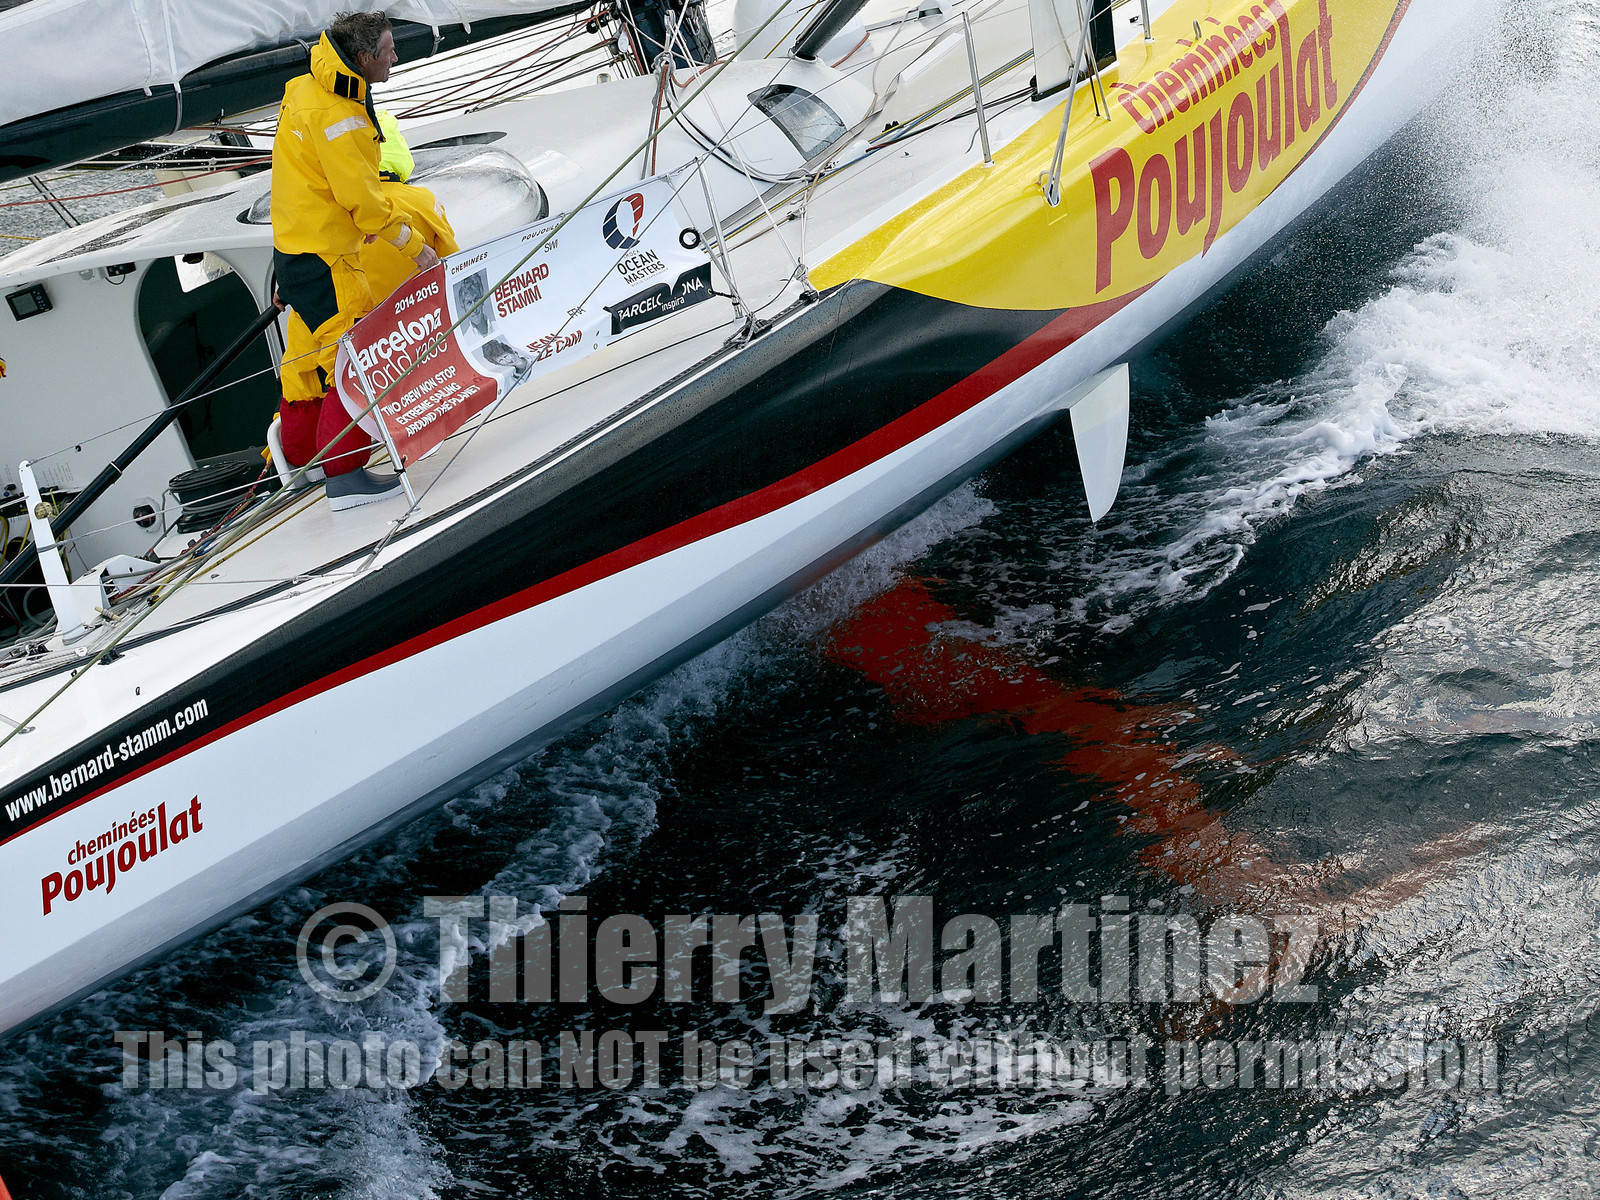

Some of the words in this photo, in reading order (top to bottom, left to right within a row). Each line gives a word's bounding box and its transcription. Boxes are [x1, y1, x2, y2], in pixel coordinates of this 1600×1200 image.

[617, 249, 658, 275] OCEAN
[623, 261, 666, 284] MASTERS
[394, 295, 415, 315] 2014
[416, 281, 439, 303] 2015
[494, 263, 549, 302] BERNARD
[497, 285, 542, 318] STAMM
[661, 296, 685, 312] inspira
[556, 330, 582, 353] CAM
[380, 401, 401, 416] TWO
[400, 387, 422, 408] CREW
[419, 377, 438, 395] NON
[434, 365, 457, 384] STOP
[395, 399, 435, 425] EXTREME
[405, 412, 437, 437] AROUND
[433, 401, 453, 416] THE
[448, 384, 480, 406] PLANET
[5, 699, 209, 822] www.bernard-stamm.com
[67, 807, 156, 865] cheminées
[41, 795, 203, 916] Poujoulat
